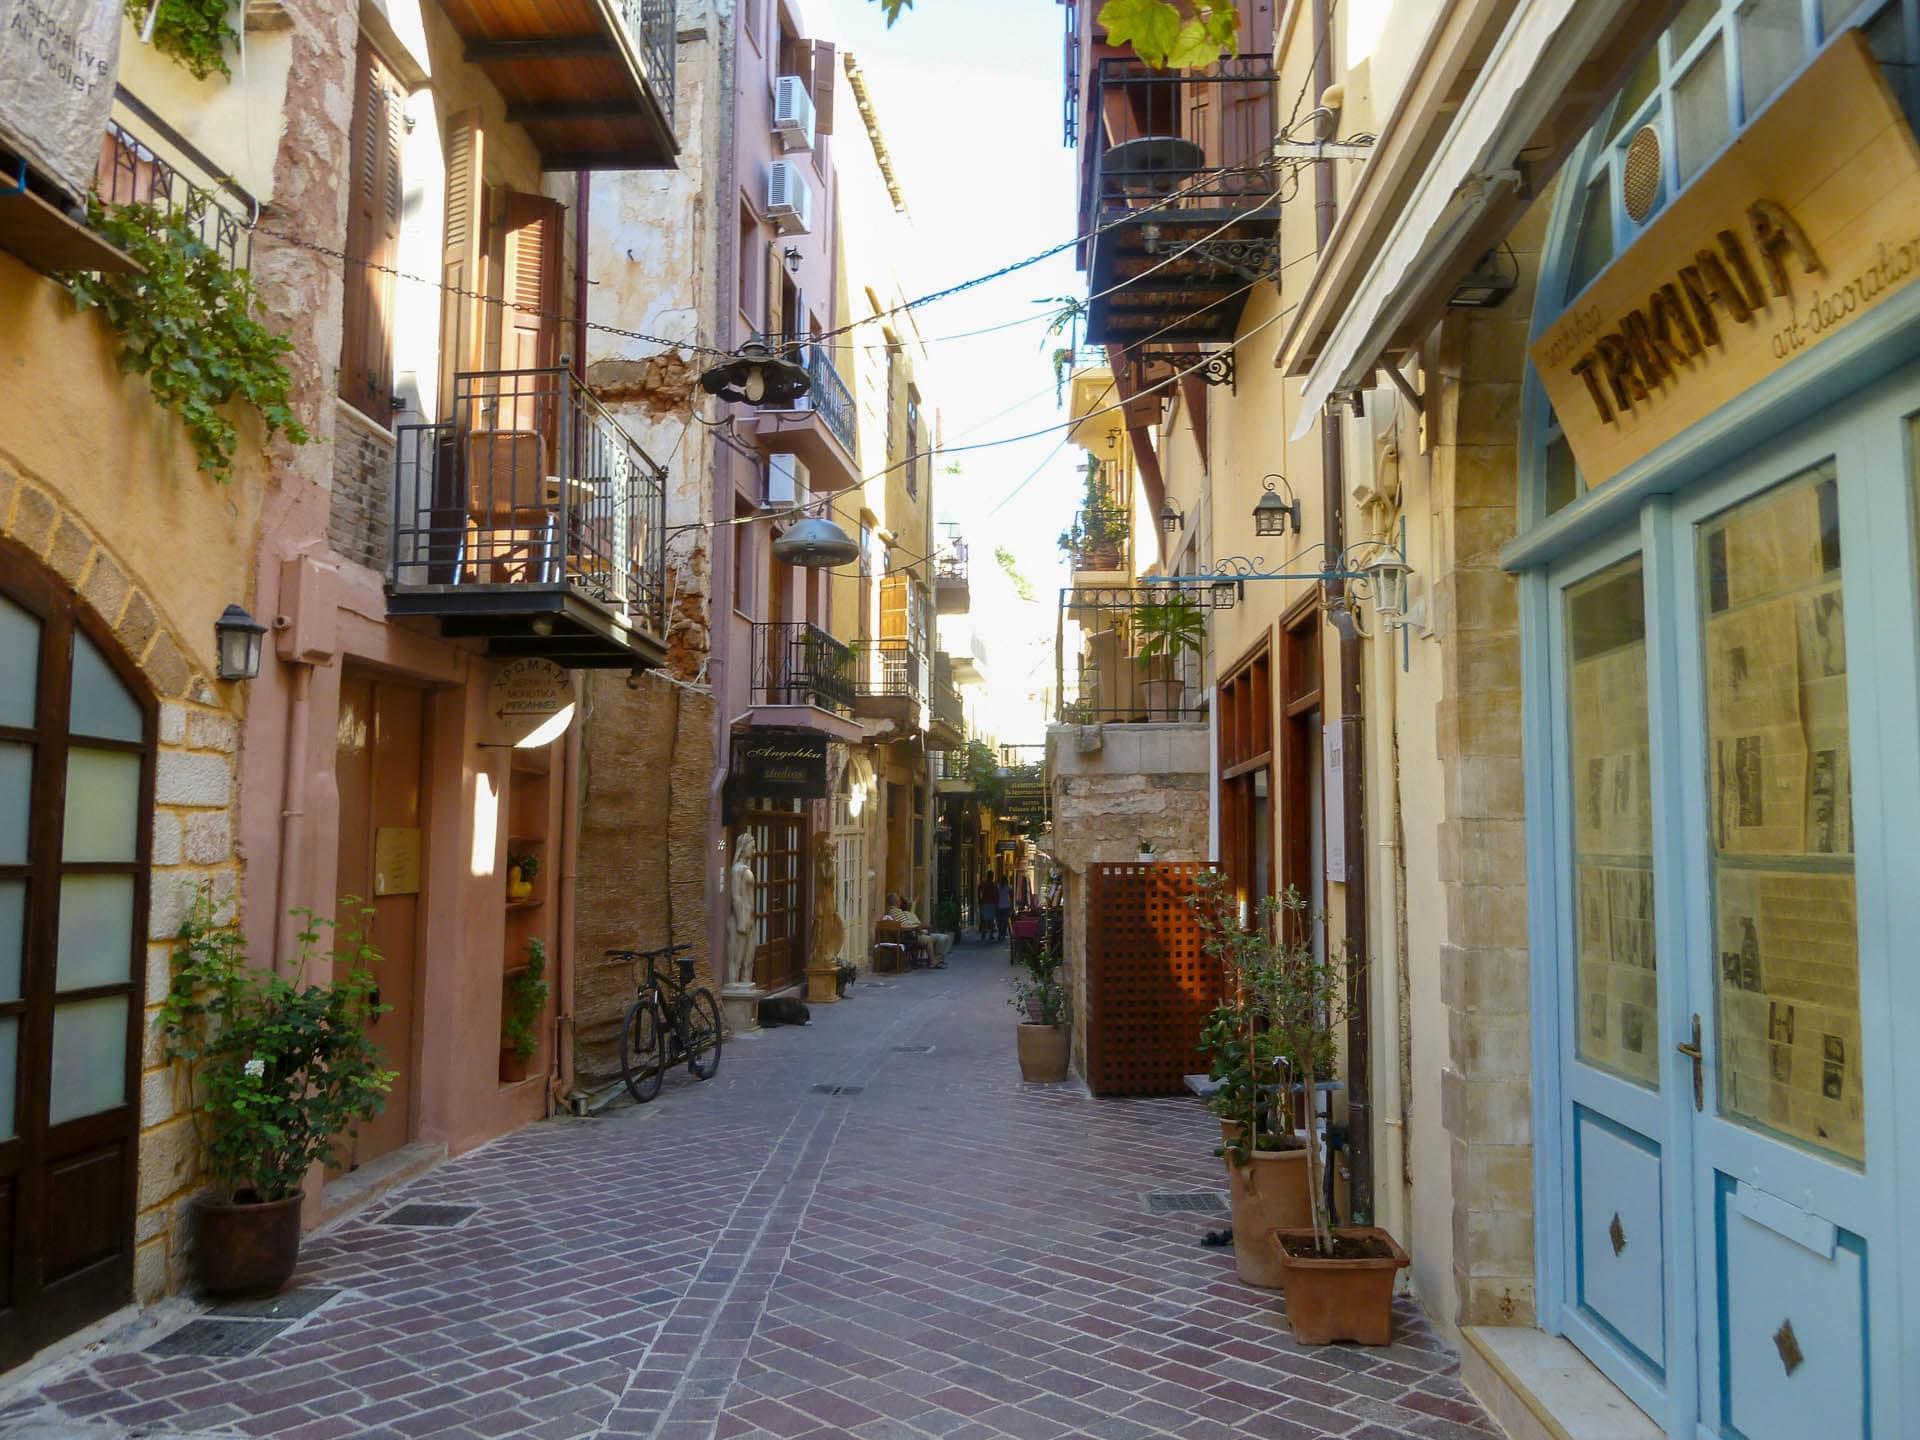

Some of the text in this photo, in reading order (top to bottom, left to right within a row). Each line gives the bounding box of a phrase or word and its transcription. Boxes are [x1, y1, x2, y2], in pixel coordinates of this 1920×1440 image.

[38, 38, 96, 96] Cooler
[495, 658, 570, 692] ΧΡΩΜΑΤΑ
[746, 745, 824, 761] Angelika
